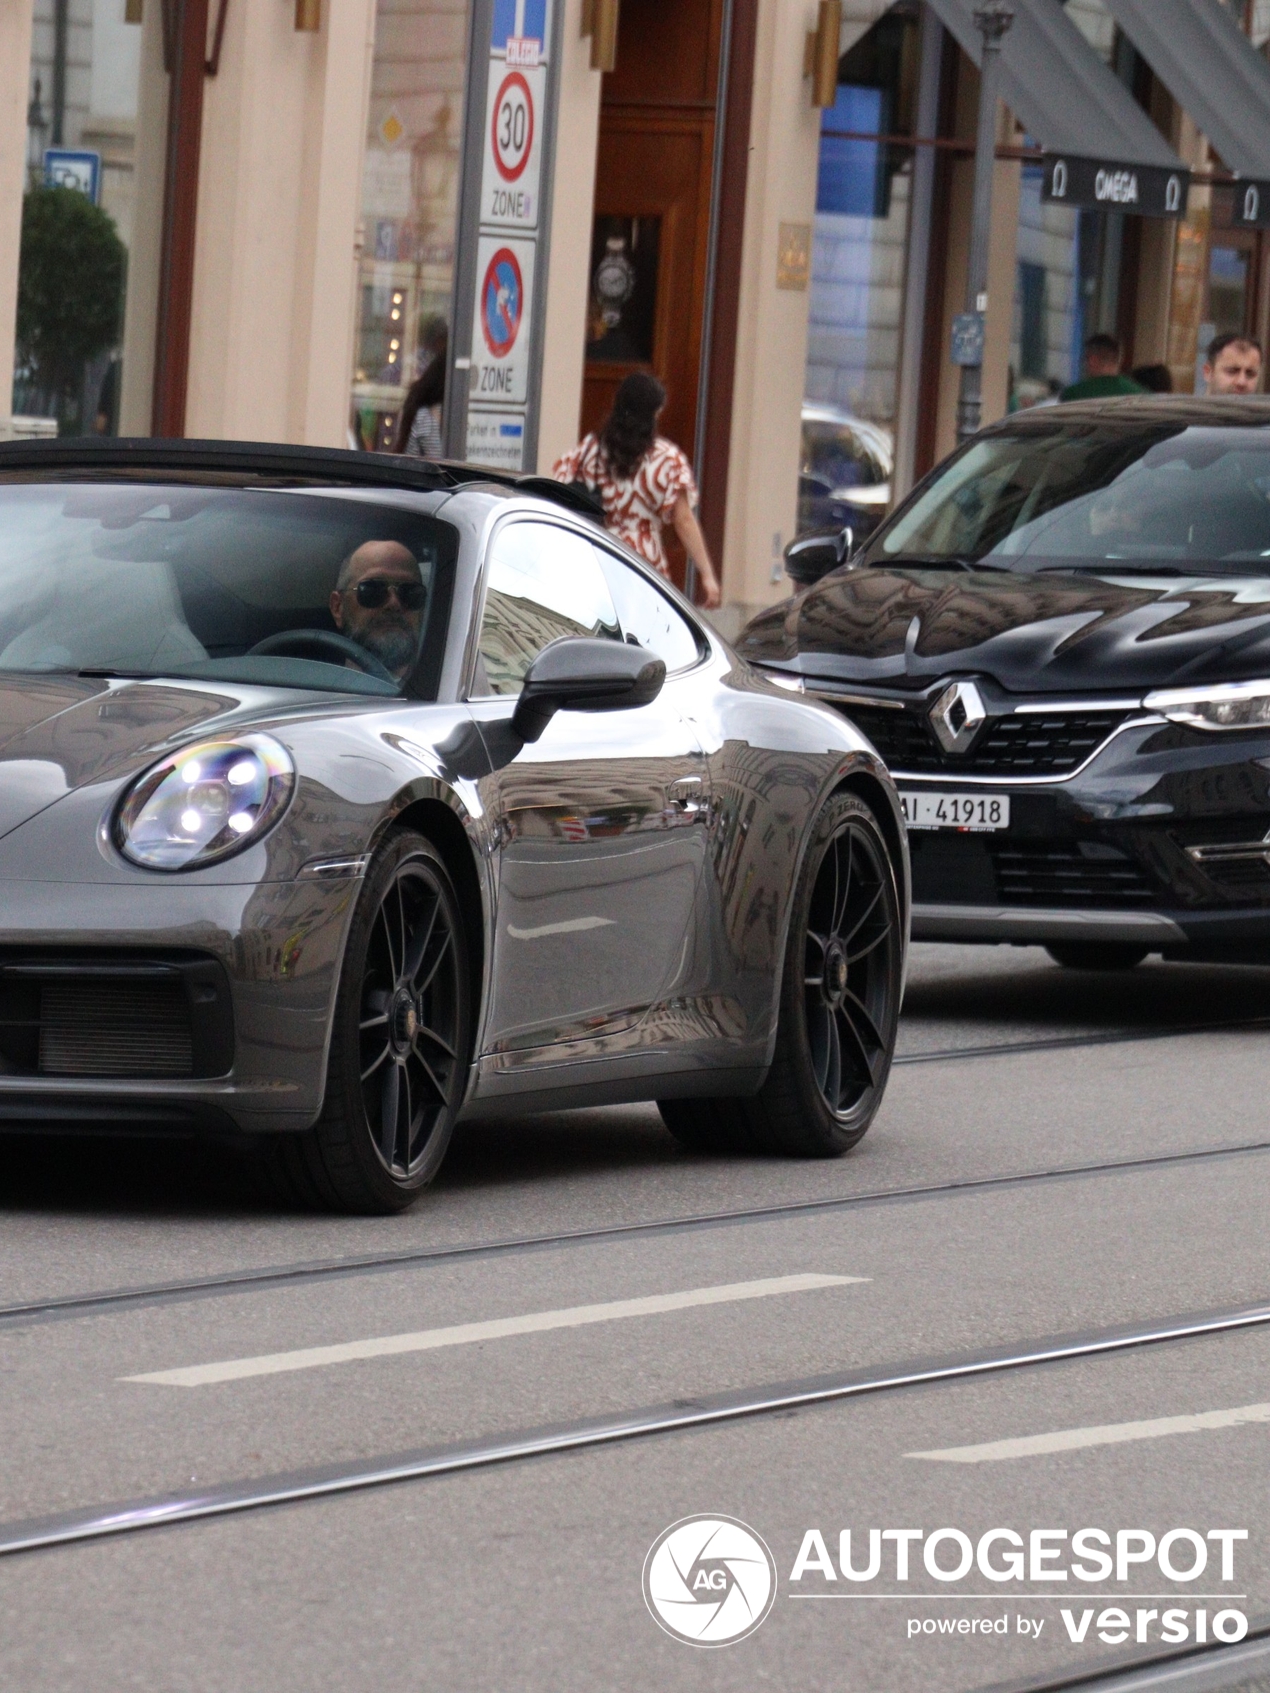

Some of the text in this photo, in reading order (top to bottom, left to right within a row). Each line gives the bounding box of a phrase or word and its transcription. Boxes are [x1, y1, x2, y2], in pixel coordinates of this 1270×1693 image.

[500, 102, 525, 152] 30
[1095, 168, 1139, 203] OMEGA
[492, 190, 524, 218] ZONE
[481, 366, 513, 393] ZONE
[935, 799, 1002, 824] 41918
